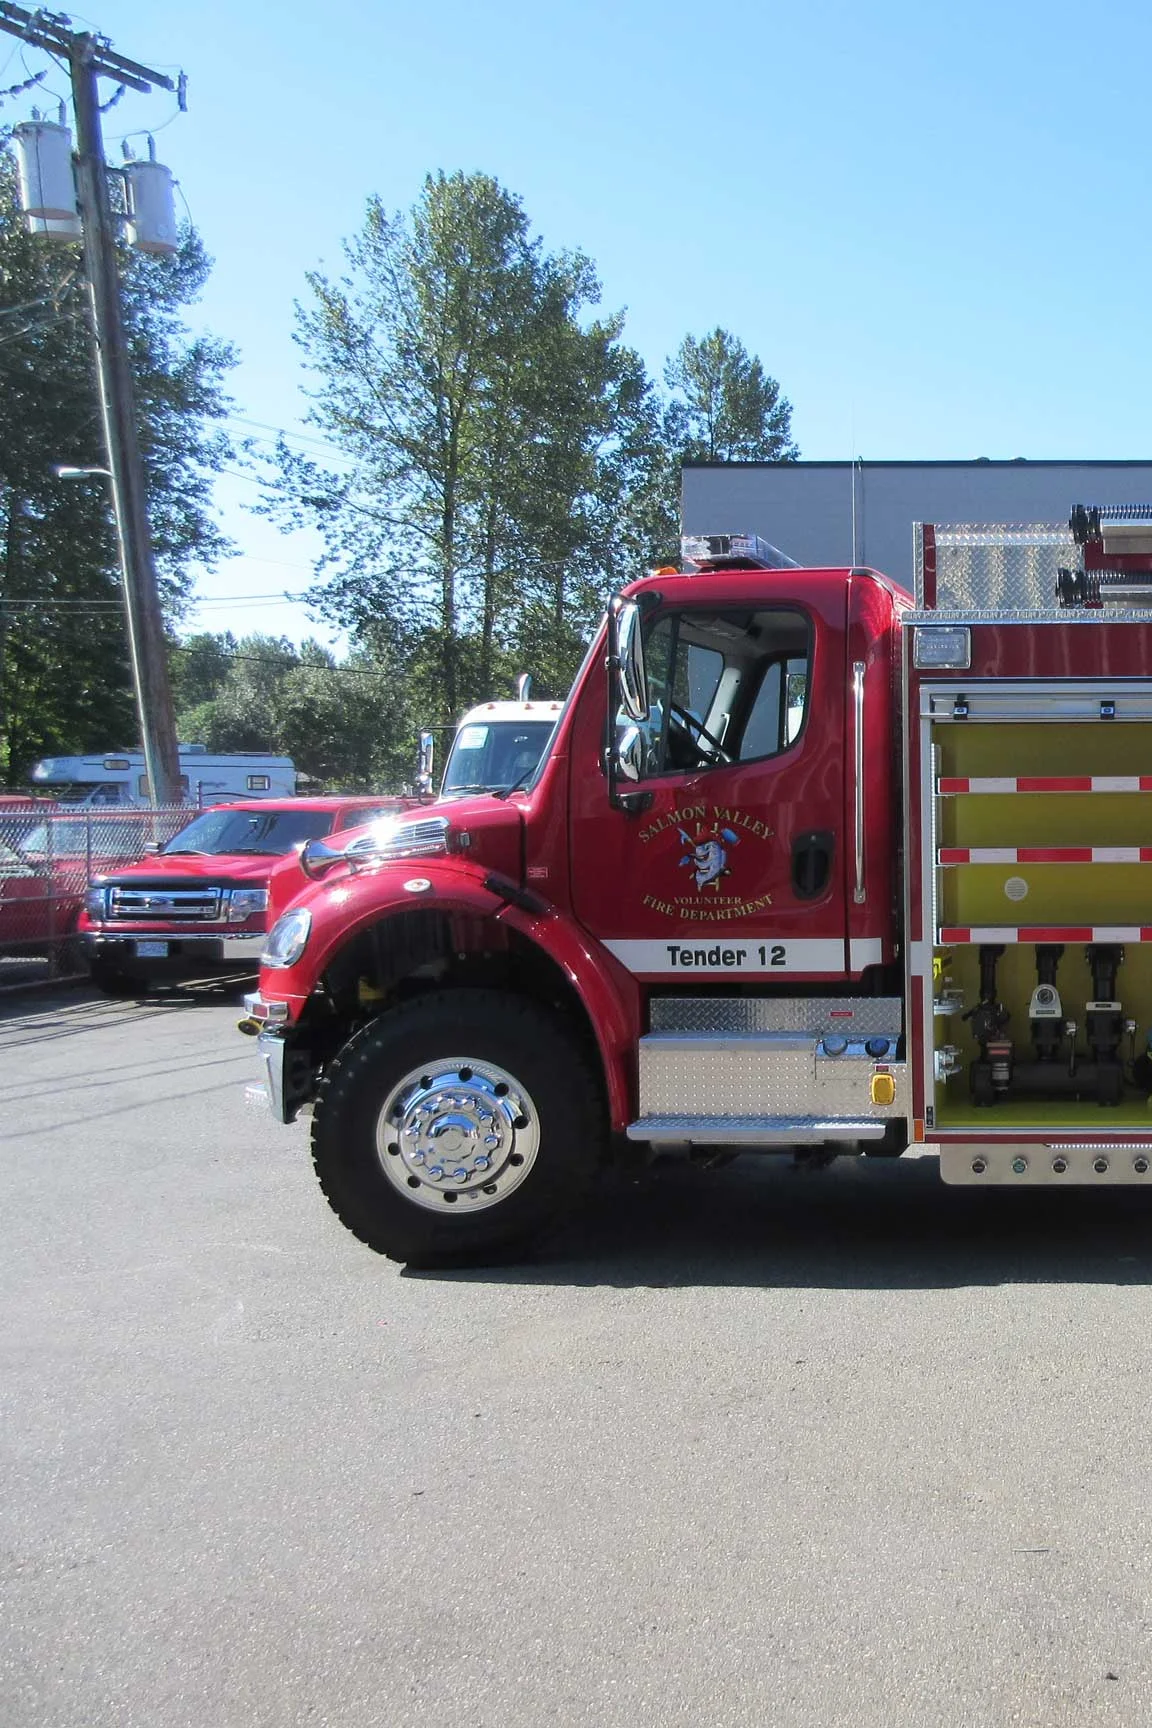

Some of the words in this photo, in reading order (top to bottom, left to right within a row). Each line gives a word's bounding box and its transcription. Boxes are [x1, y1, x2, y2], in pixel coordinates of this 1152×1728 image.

[638, 805, 705, 843] SALMON
[713, 806, 775, 840] VALLEY
[643, 895, 675, 916] FIRE
[680, 893, 773, 921] DEPARTMENT
[674, 896, 742, 905] VOLUNTEER
[667, 945, 747, 966] Tender
[758, 945, 786, 966] 12
